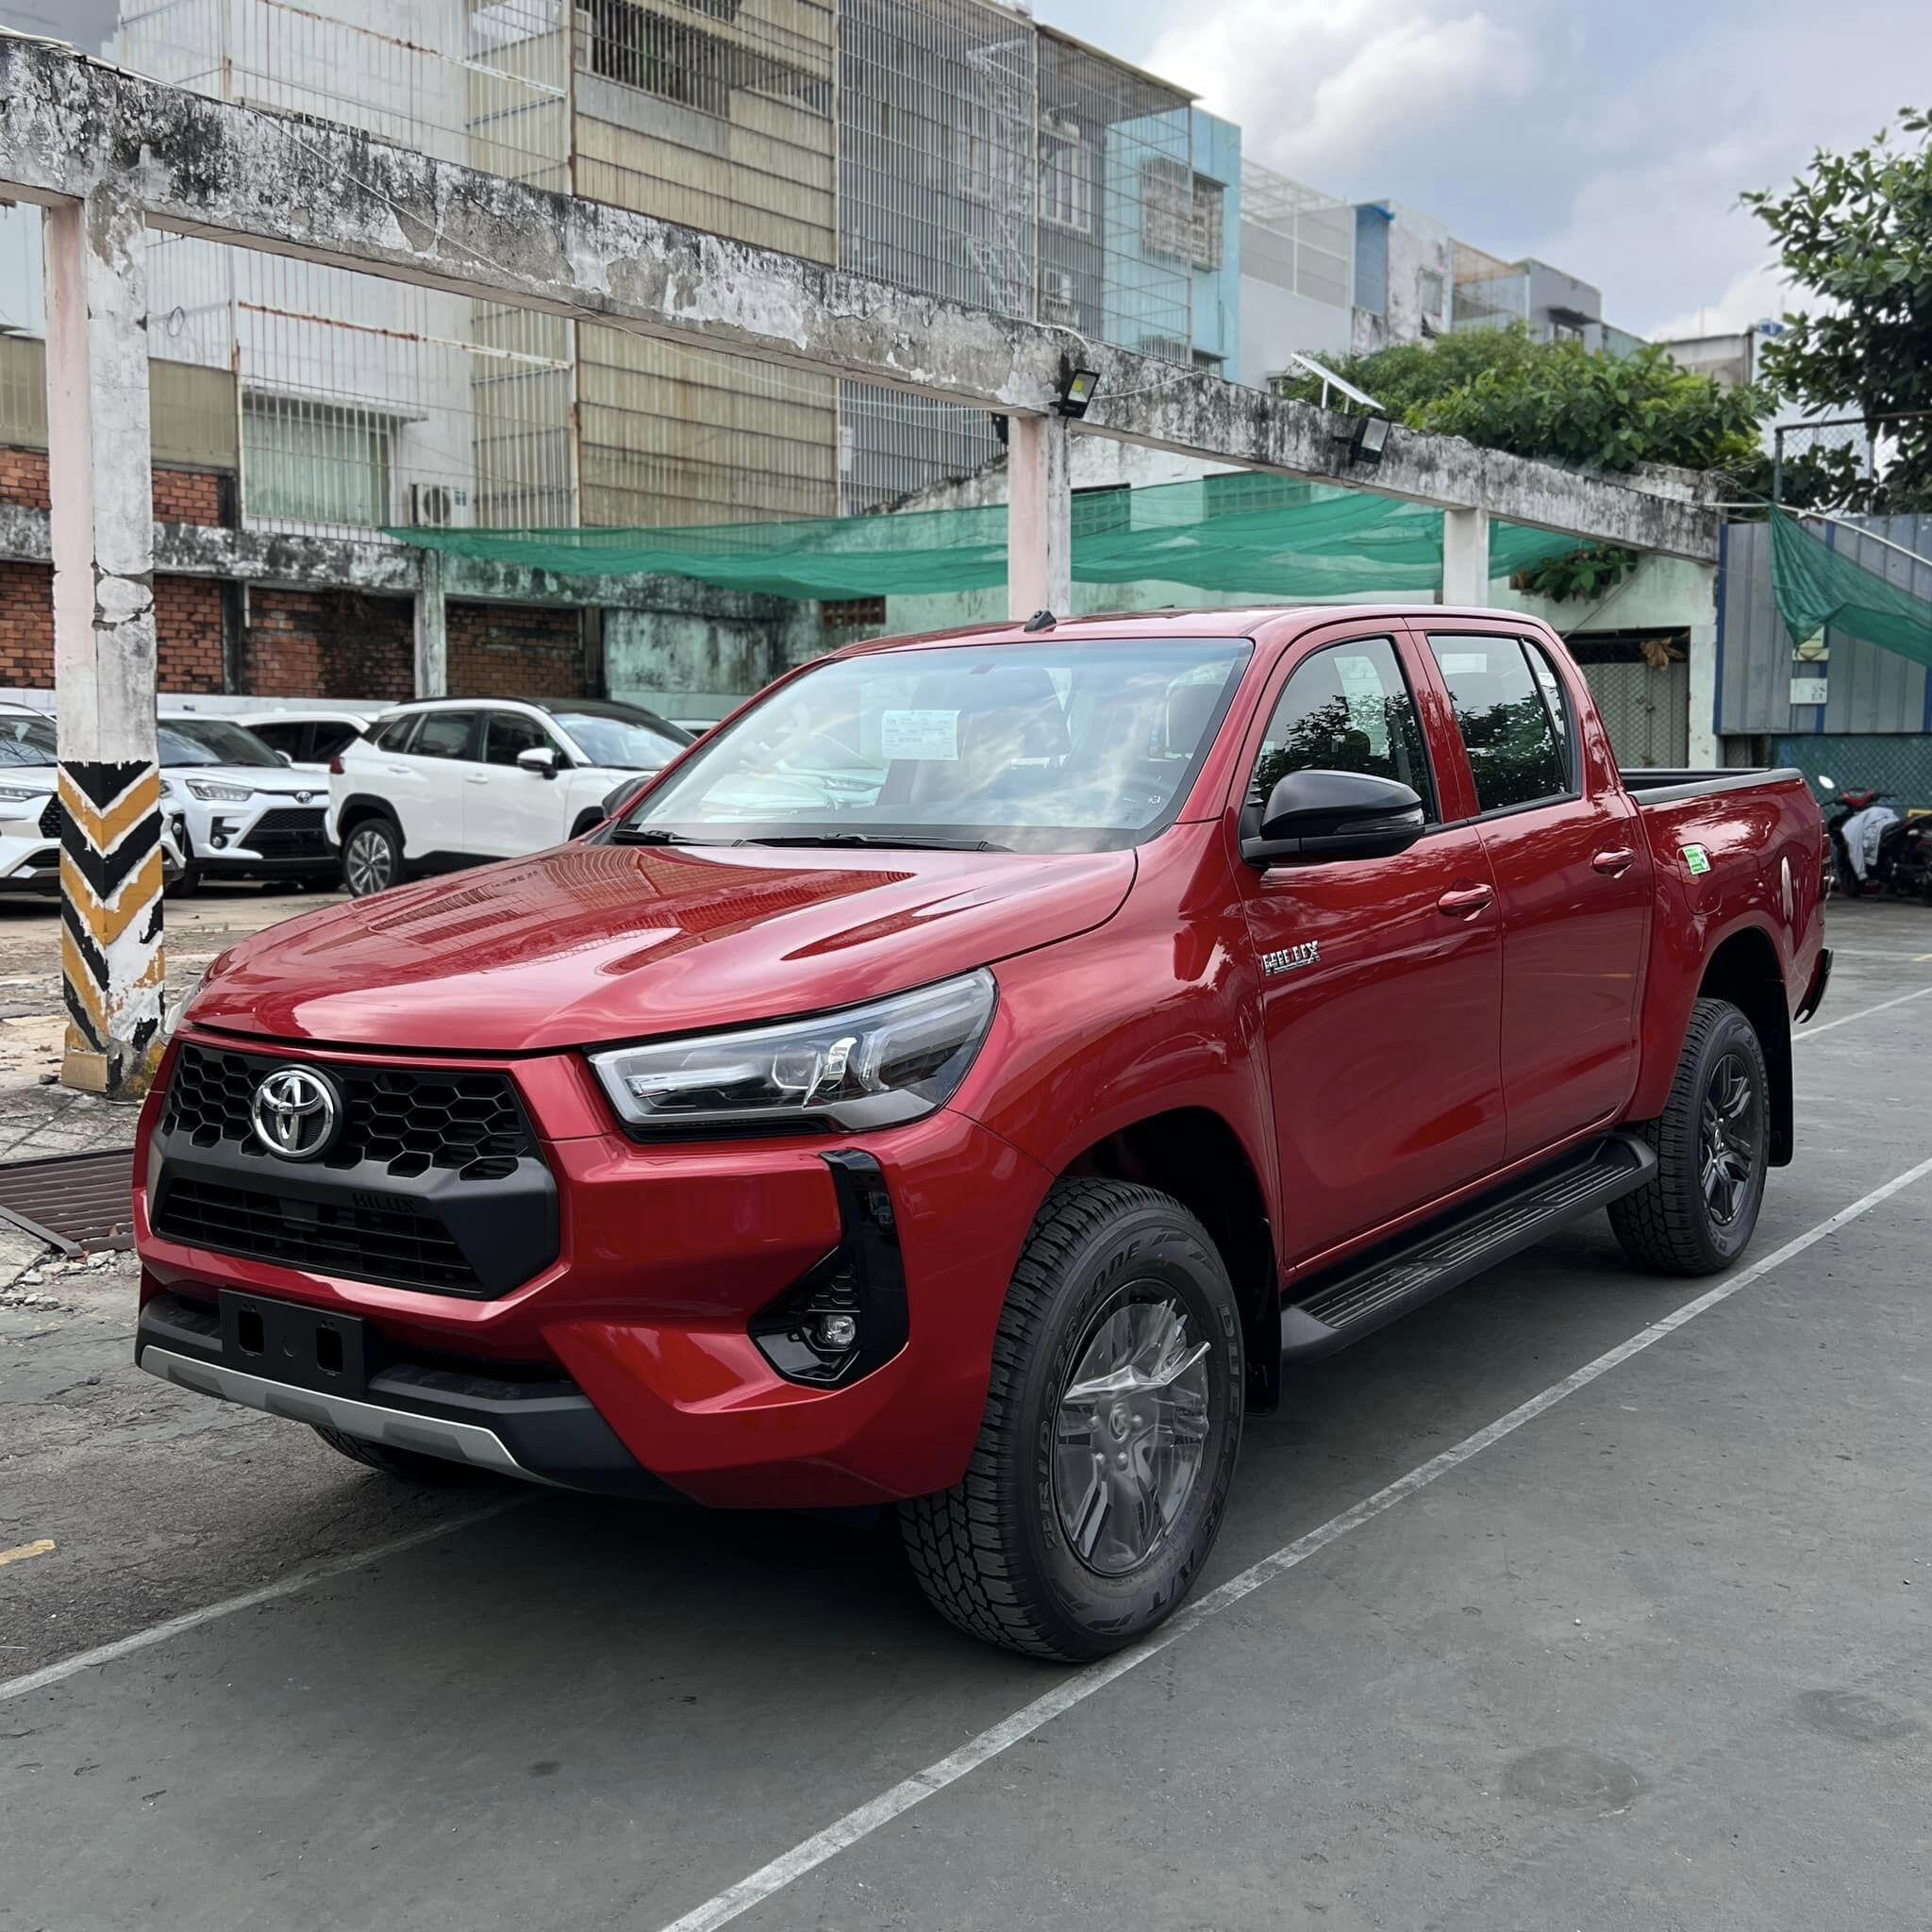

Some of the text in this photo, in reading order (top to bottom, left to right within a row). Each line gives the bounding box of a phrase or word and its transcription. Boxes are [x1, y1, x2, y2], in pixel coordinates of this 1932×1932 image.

[1262, 941, 1320, 976] HILUX
[352, 1191, 416, 1214] HILUX
[1035, 1240, 1141, 1551] BRIDGESTONE
